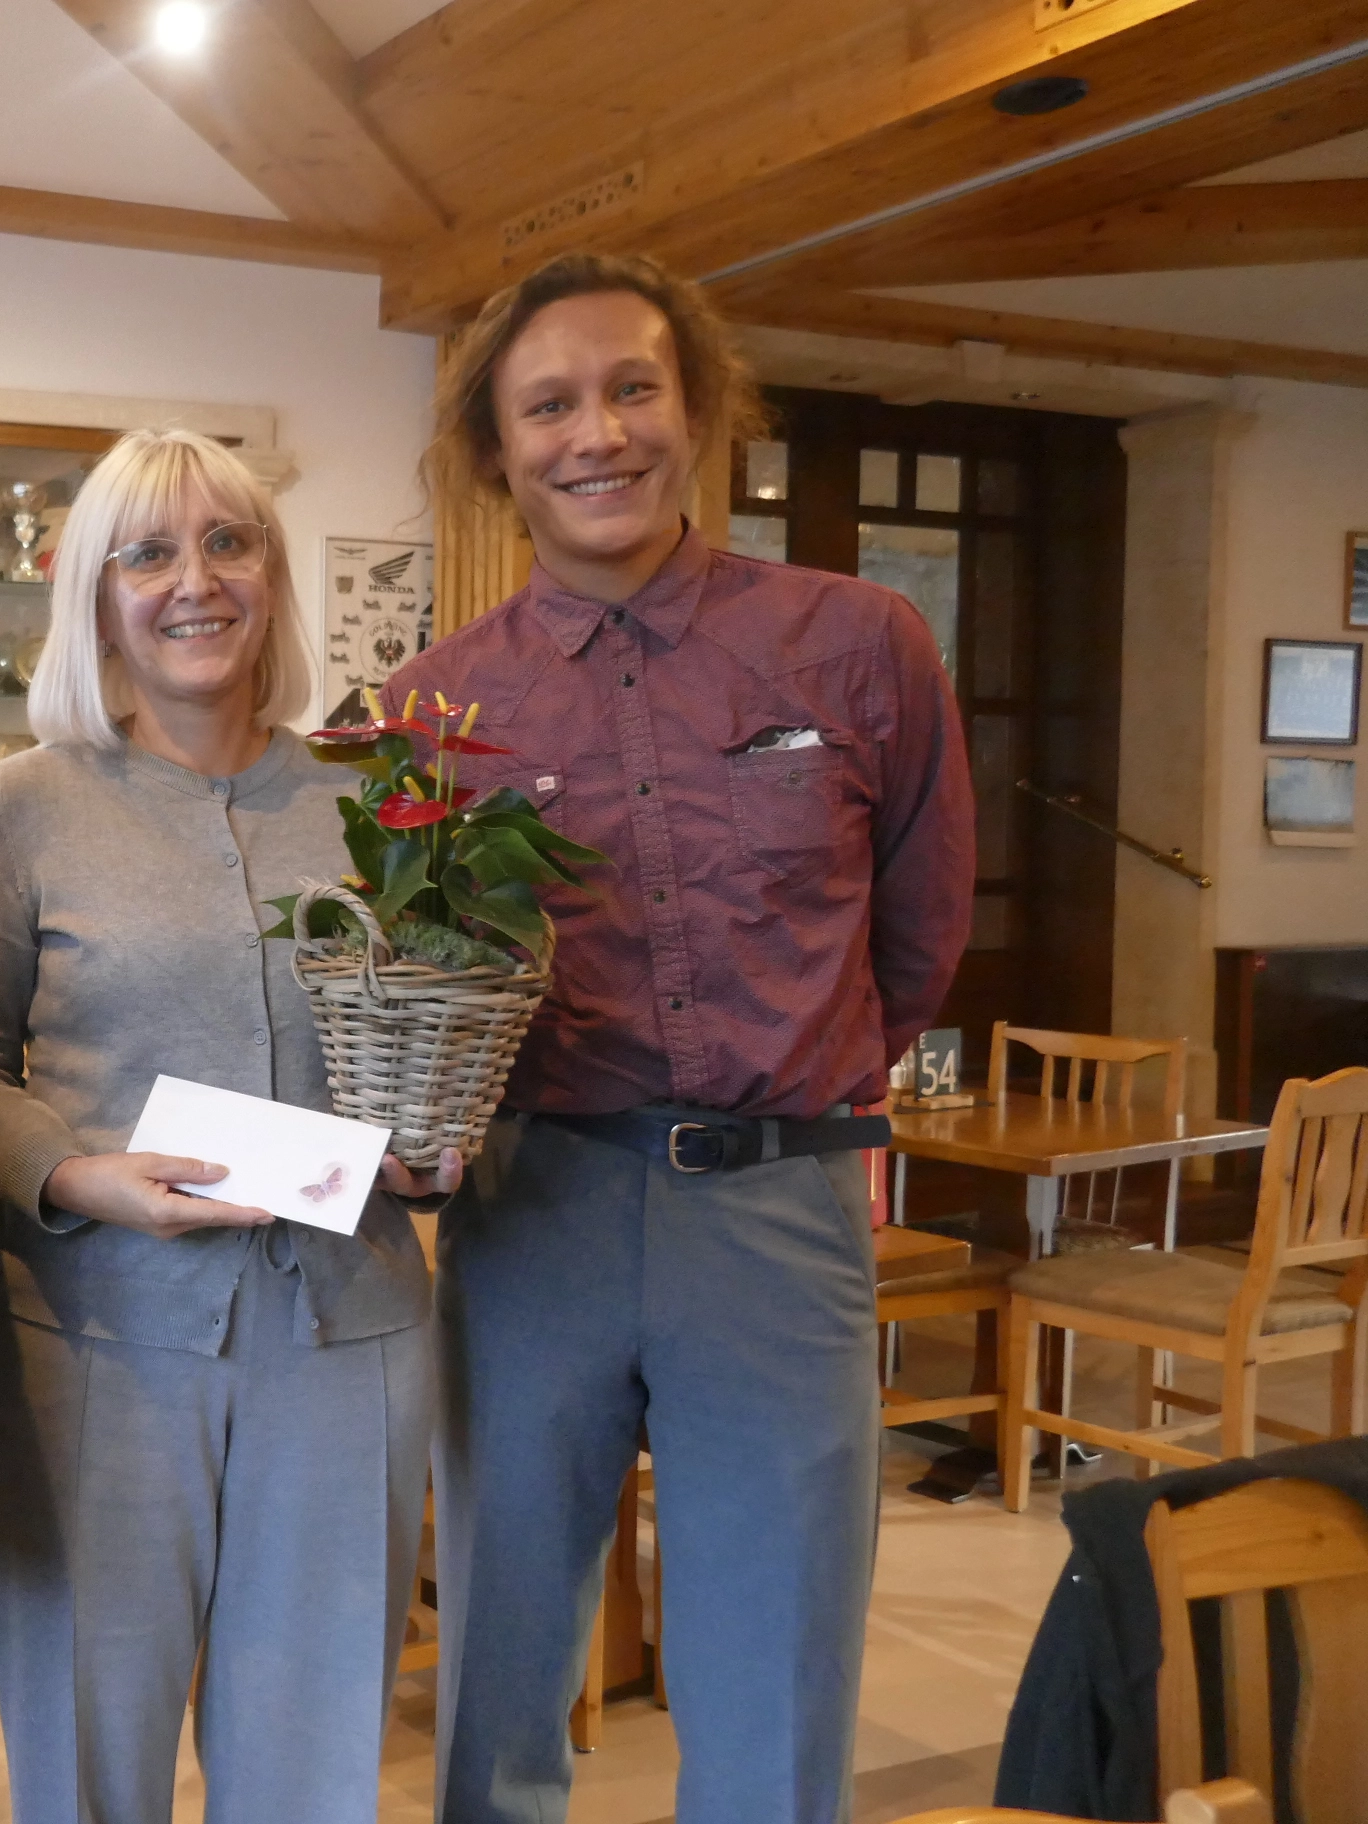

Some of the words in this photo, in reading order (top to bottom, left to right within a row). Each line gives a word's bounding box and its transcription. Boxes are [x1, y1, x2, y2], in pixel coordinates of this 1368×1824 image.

[368, 585, 415, 594] HONDA
[919, 1033, 927, 1049] E
[921, 1049, 957, 1096] 54
